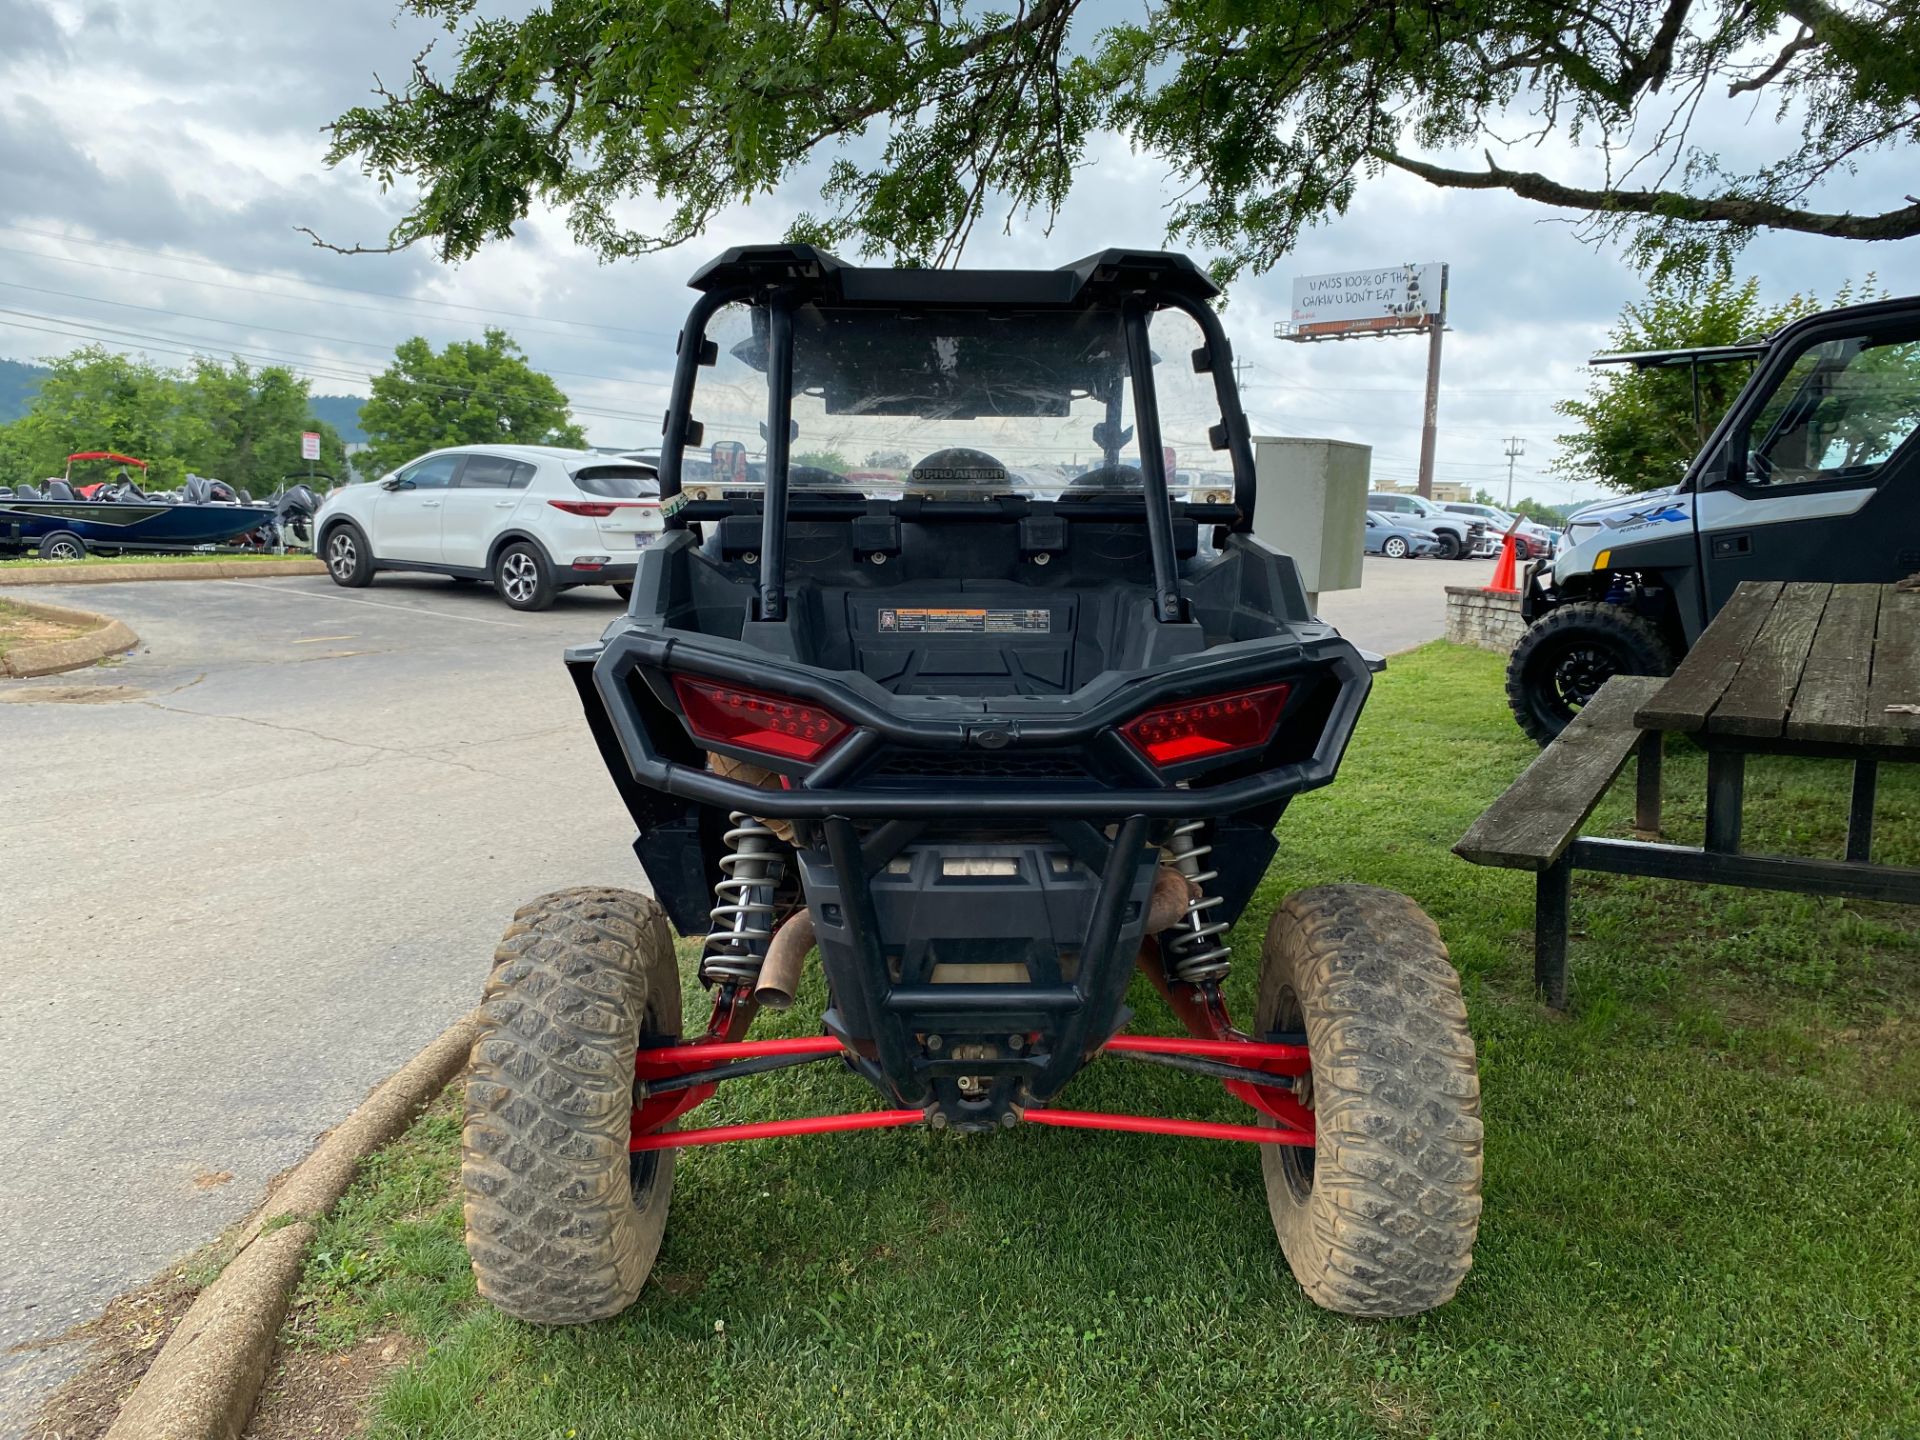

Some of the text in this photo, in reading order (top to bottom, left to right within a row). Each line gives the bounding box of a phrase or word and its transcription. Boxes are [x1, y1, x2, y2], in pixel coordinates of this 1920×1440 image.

[1309, 271, 1409, 291] U MISS 100% OF THA
[1335, 294, 1343, 304] U
[1345, 288, 1374, 303] DON'T
[1376, 287, 1396, 301] EAT
[925, 469, 1005, 479] PRO ARMOR
[1621, 502, 1686, 524] XP
[1618, 520, 1662, 534] KINETIC
